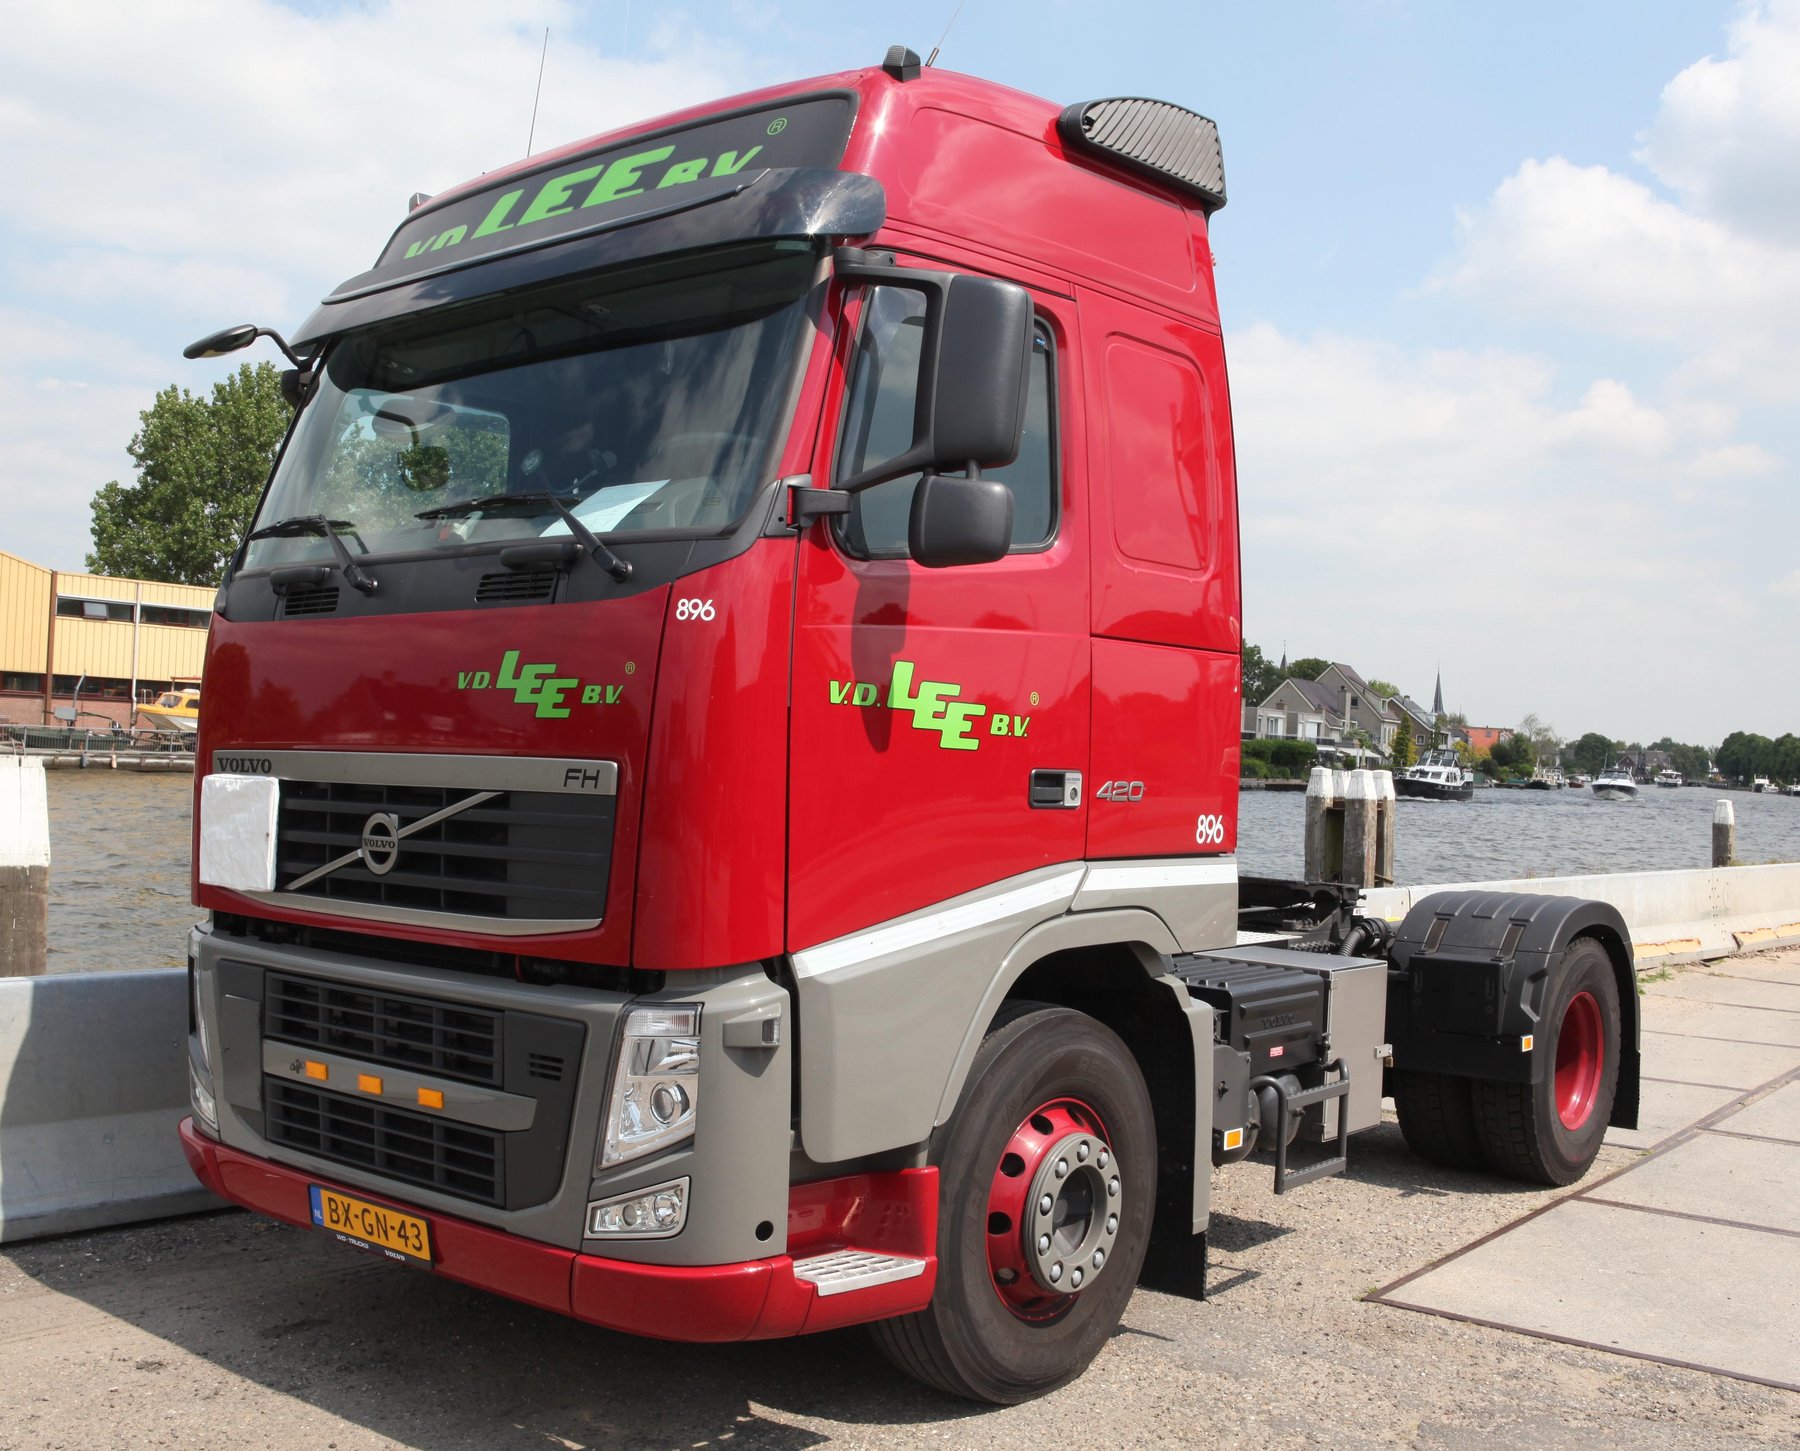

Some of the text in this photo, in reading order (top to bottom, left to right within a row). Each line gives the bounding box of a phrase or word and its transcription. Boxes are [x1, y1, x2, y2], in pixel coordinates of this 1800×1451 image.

[470, 144, 676, 239] LEE
[676, 598, 716, 621] 896
[457, 671, 492, 689] V.D.
[496, 650, 578, 718] LEE
[581, 685, 624, 704] B.V.
[829, 680, 881, 707] V.D.
[887, 660, 986, 750] LEE
[990, 713, 1031, 737] B.V.
[217, 757, 272, 774] VOLVO
[563, 768, 600, 789] FH
[1096, 780, 1145, 802] 420
[1196, 814, 1224, 844] 896
[363, 838, 396, 849] VOLVO
[314, 1208, 323, 1220] NL
[327, 1196, 423, 1252] BX-GN-43
[384, 1249, 406, 1261] VOLVO
